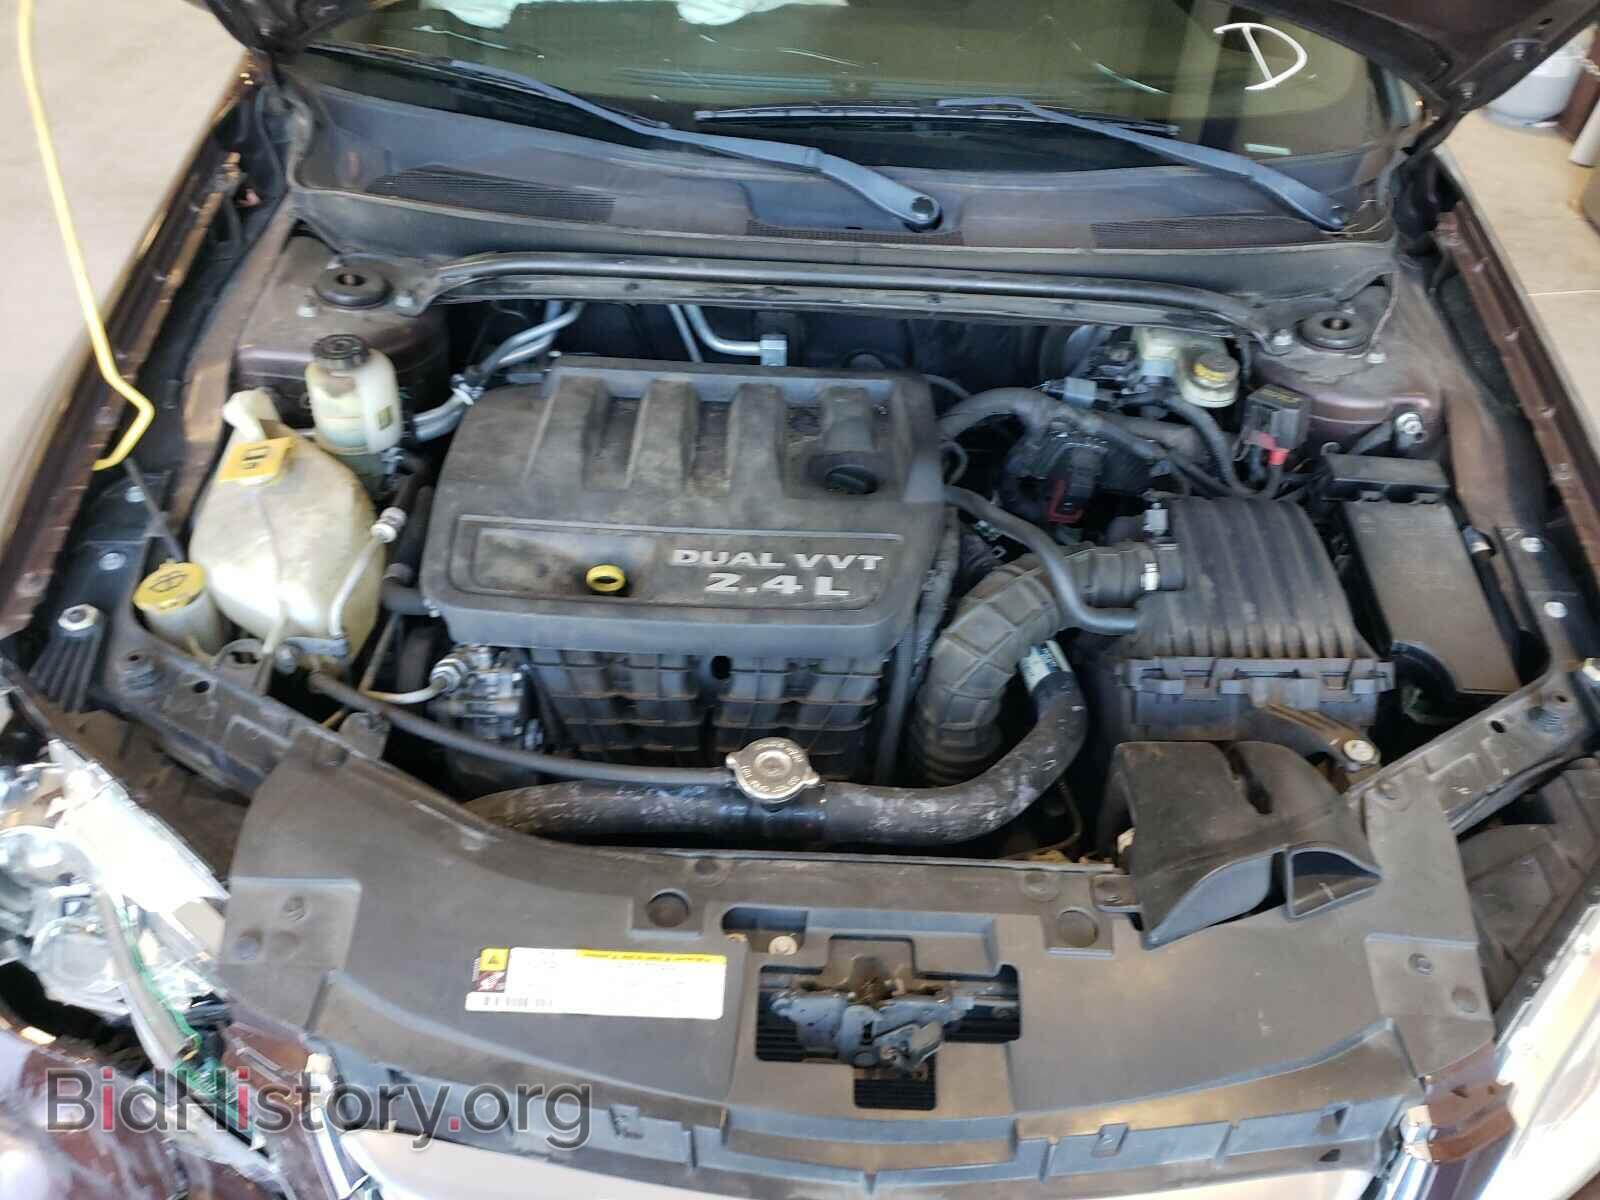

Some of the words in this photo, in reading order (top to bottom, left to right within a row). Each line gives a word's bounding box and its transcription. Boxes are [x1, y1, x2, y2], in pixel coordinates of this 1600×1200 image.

[671, 549, 786, 568] DUAL
[794, 553, 885, 570] VVT
[704, 572, 804, 595] 2.4
[814, 575, 849, 597] L
